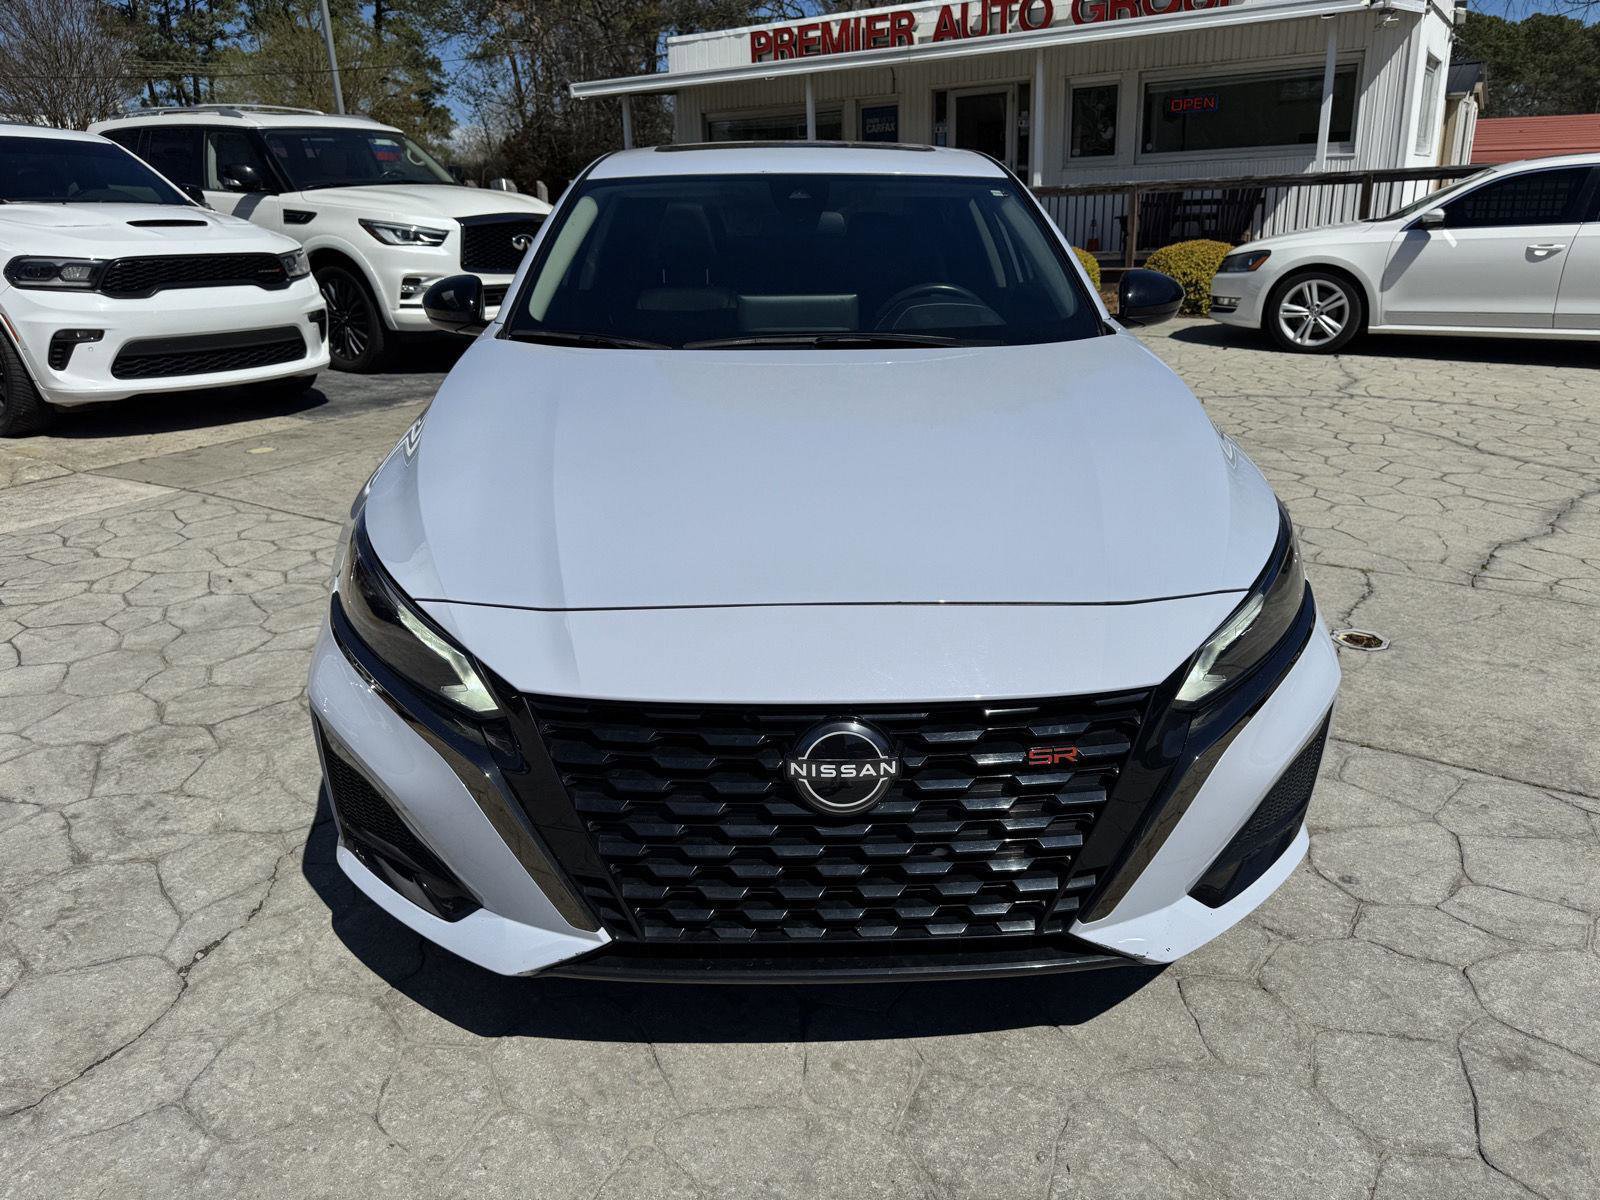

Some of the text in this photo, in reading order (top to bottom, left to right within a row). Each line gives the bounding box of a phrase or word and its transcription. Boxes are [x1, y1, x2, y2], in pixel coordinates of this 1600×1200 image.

[750, 10, 916, 63] PREMIER
[932, 0, 1054, 42] AUTO
[1169, 96, 1215, 112] OPEN
[1028, 746, 1078, 765] SR
[790, 760, 896, 778] NISSAN
